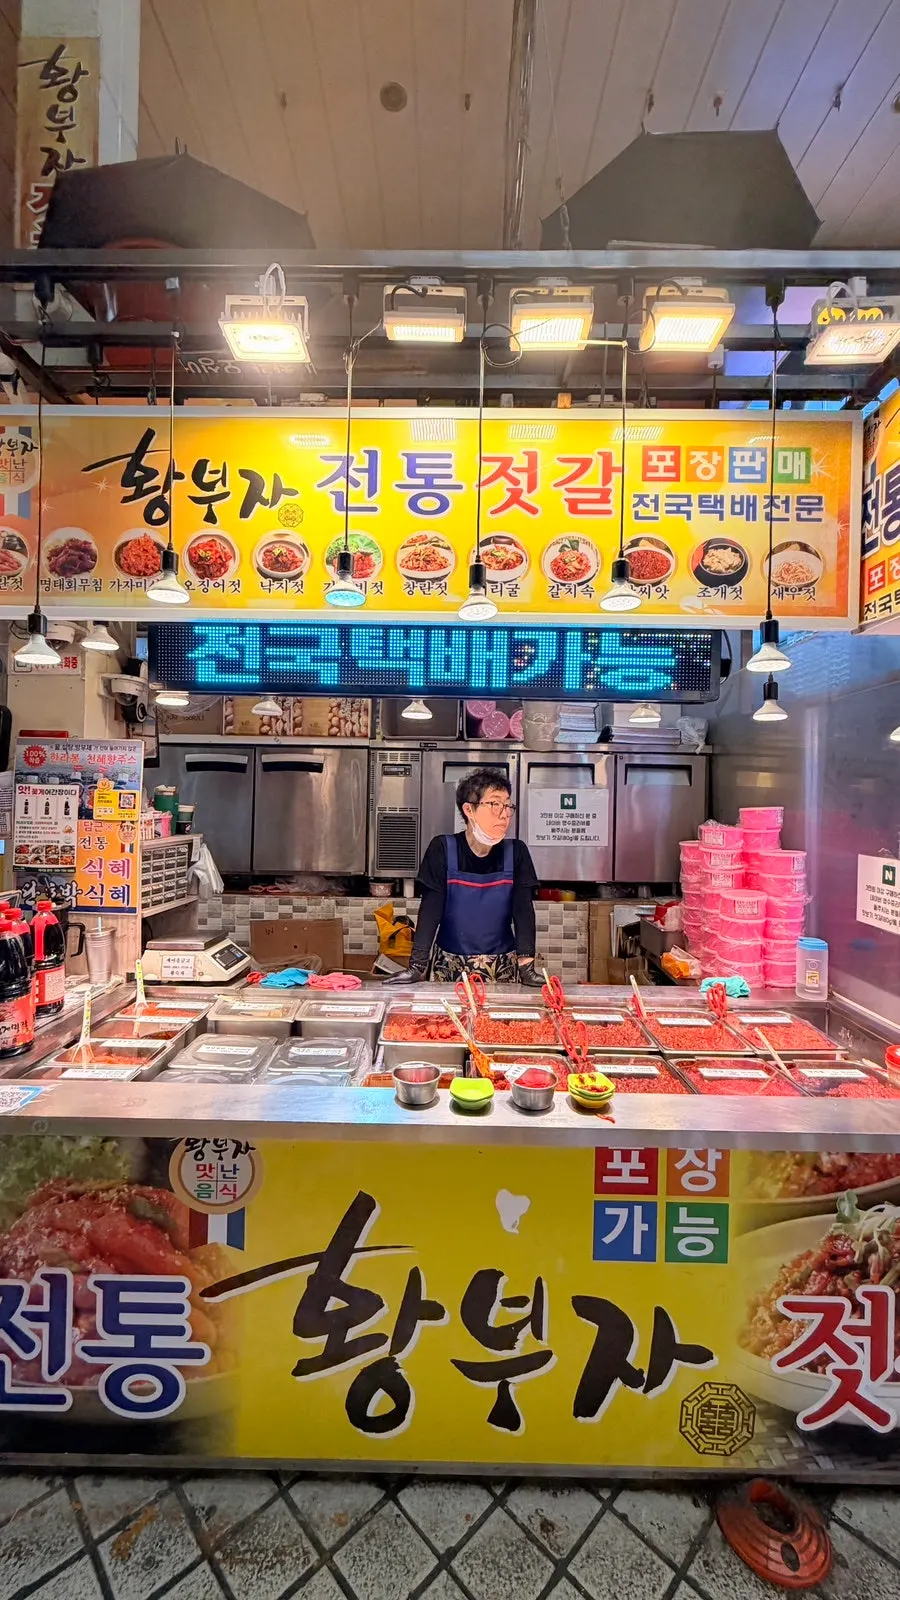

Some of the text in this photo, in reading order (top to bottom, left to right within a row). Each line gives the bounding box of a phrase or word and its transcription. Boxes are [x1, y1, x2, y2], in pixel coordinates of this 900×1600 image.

[18, 44, 91, 176] 황부자
[81, 427, 625, 526] 황부자 전통 젓갈
[646, 450, 806, 481] 포장판매
[632, 493, 824, 523] 전국택배전문
[40, 578, 103, 592] 명태회무침
[184, 579, 241, 594] 오징어젓
[260, 580, 305, 595] 낙지젓
[402, 580, 449, 597] 창란젓
[547, 582, 595, 599] 갈치속
[696, 585, 744, 601] 조개젓
[771, 585, 816, 602] 새우젓
[185, 624, 676, 690] 전국택배가능
[26, 749, 45, 757] 100%
[50, 752, 80, 765] 한라봉
[564, 797, 573, 806] N
[80, 836, 108, 851] 전통
[82, 858, 132, 880] 식혜
[84, 883, 132, 907] 식혜
[170, 1138, 256, 1162] 황부자
[195, 1163, 240, 1180] 맛난
[602, 1147, 722, 1192] 포장
[193, 1183, 240, 1200] 음식
[601, 1206, 720, 1258] 가능
[0, 1272, 206, 1414] 전통
[199, 1189, 714, 1435] 황부자
